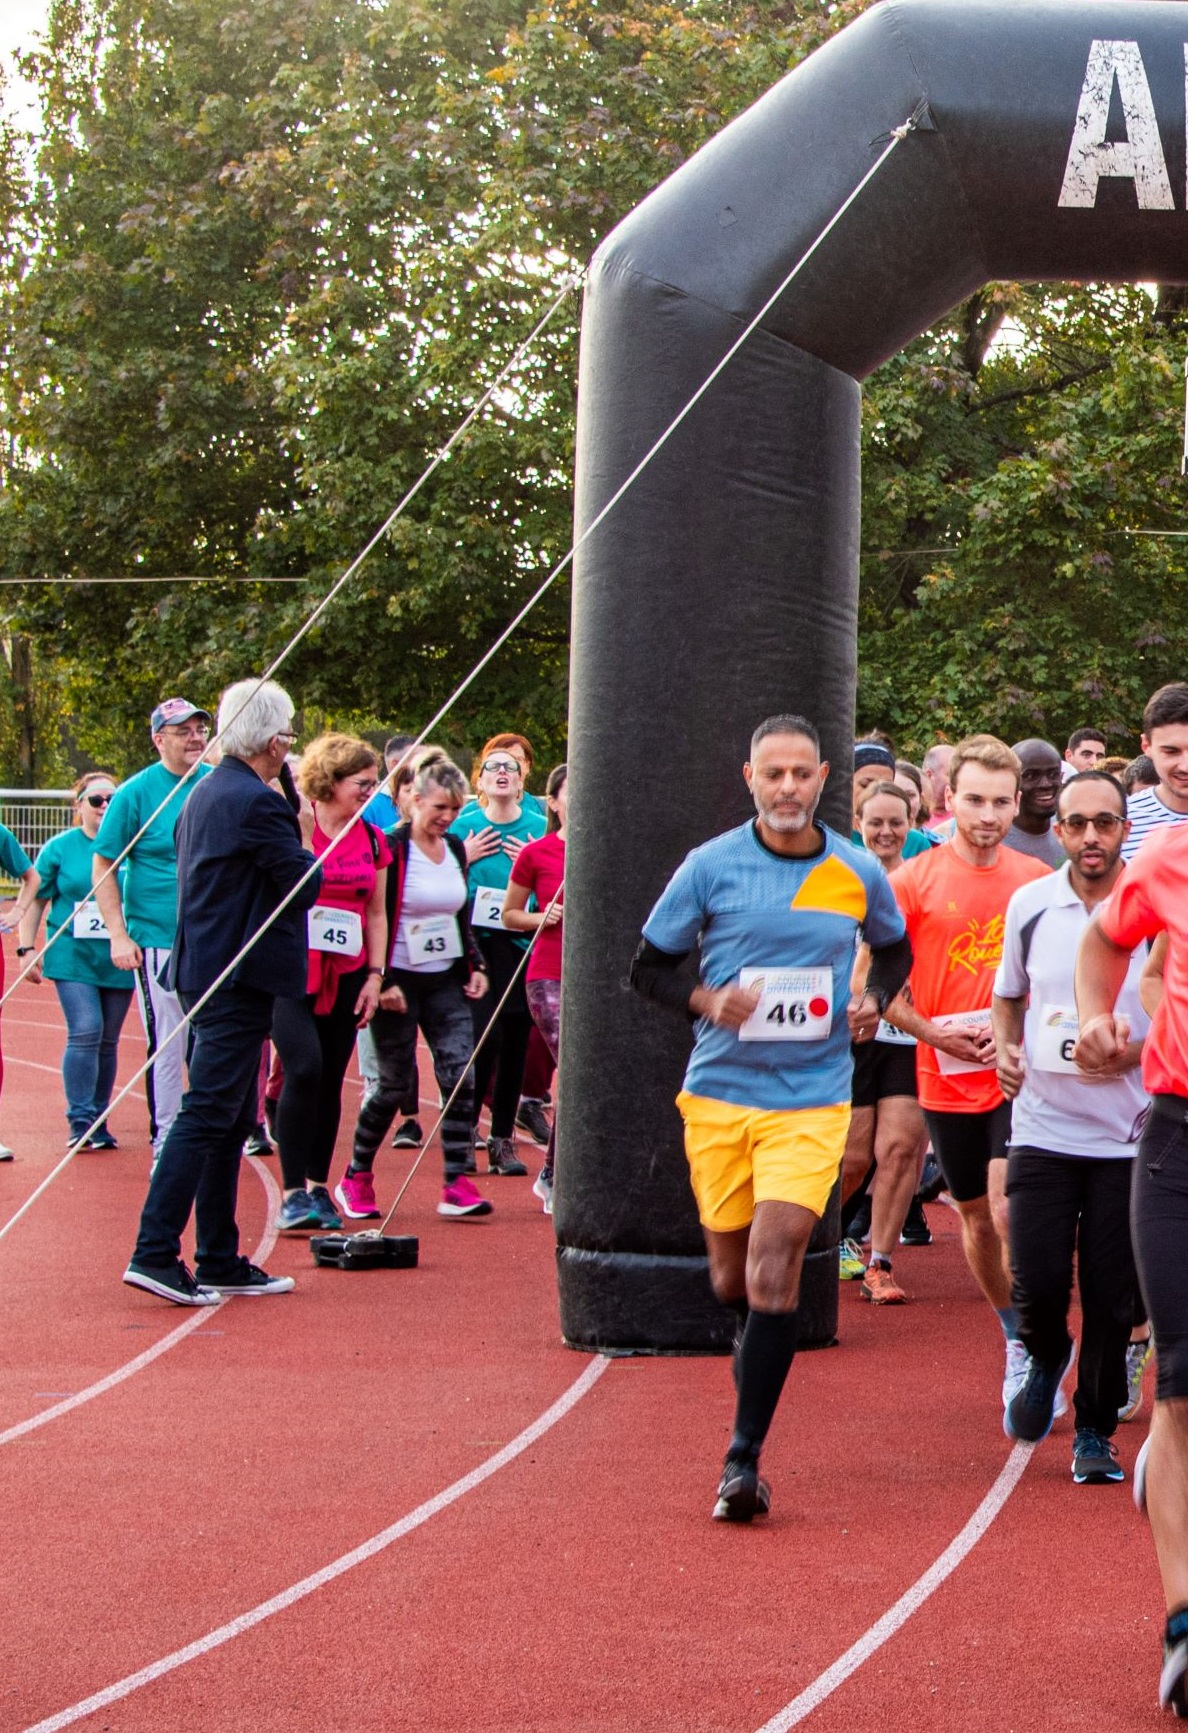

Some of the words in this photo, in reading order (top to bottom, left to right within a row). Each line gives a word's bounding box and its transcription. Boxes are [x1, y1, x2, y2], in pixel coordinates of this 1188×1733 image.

[323, 928, 347, 945] 45
[424, 937, 446, 952] 43
[766, 1000, 807, 1027] 46
